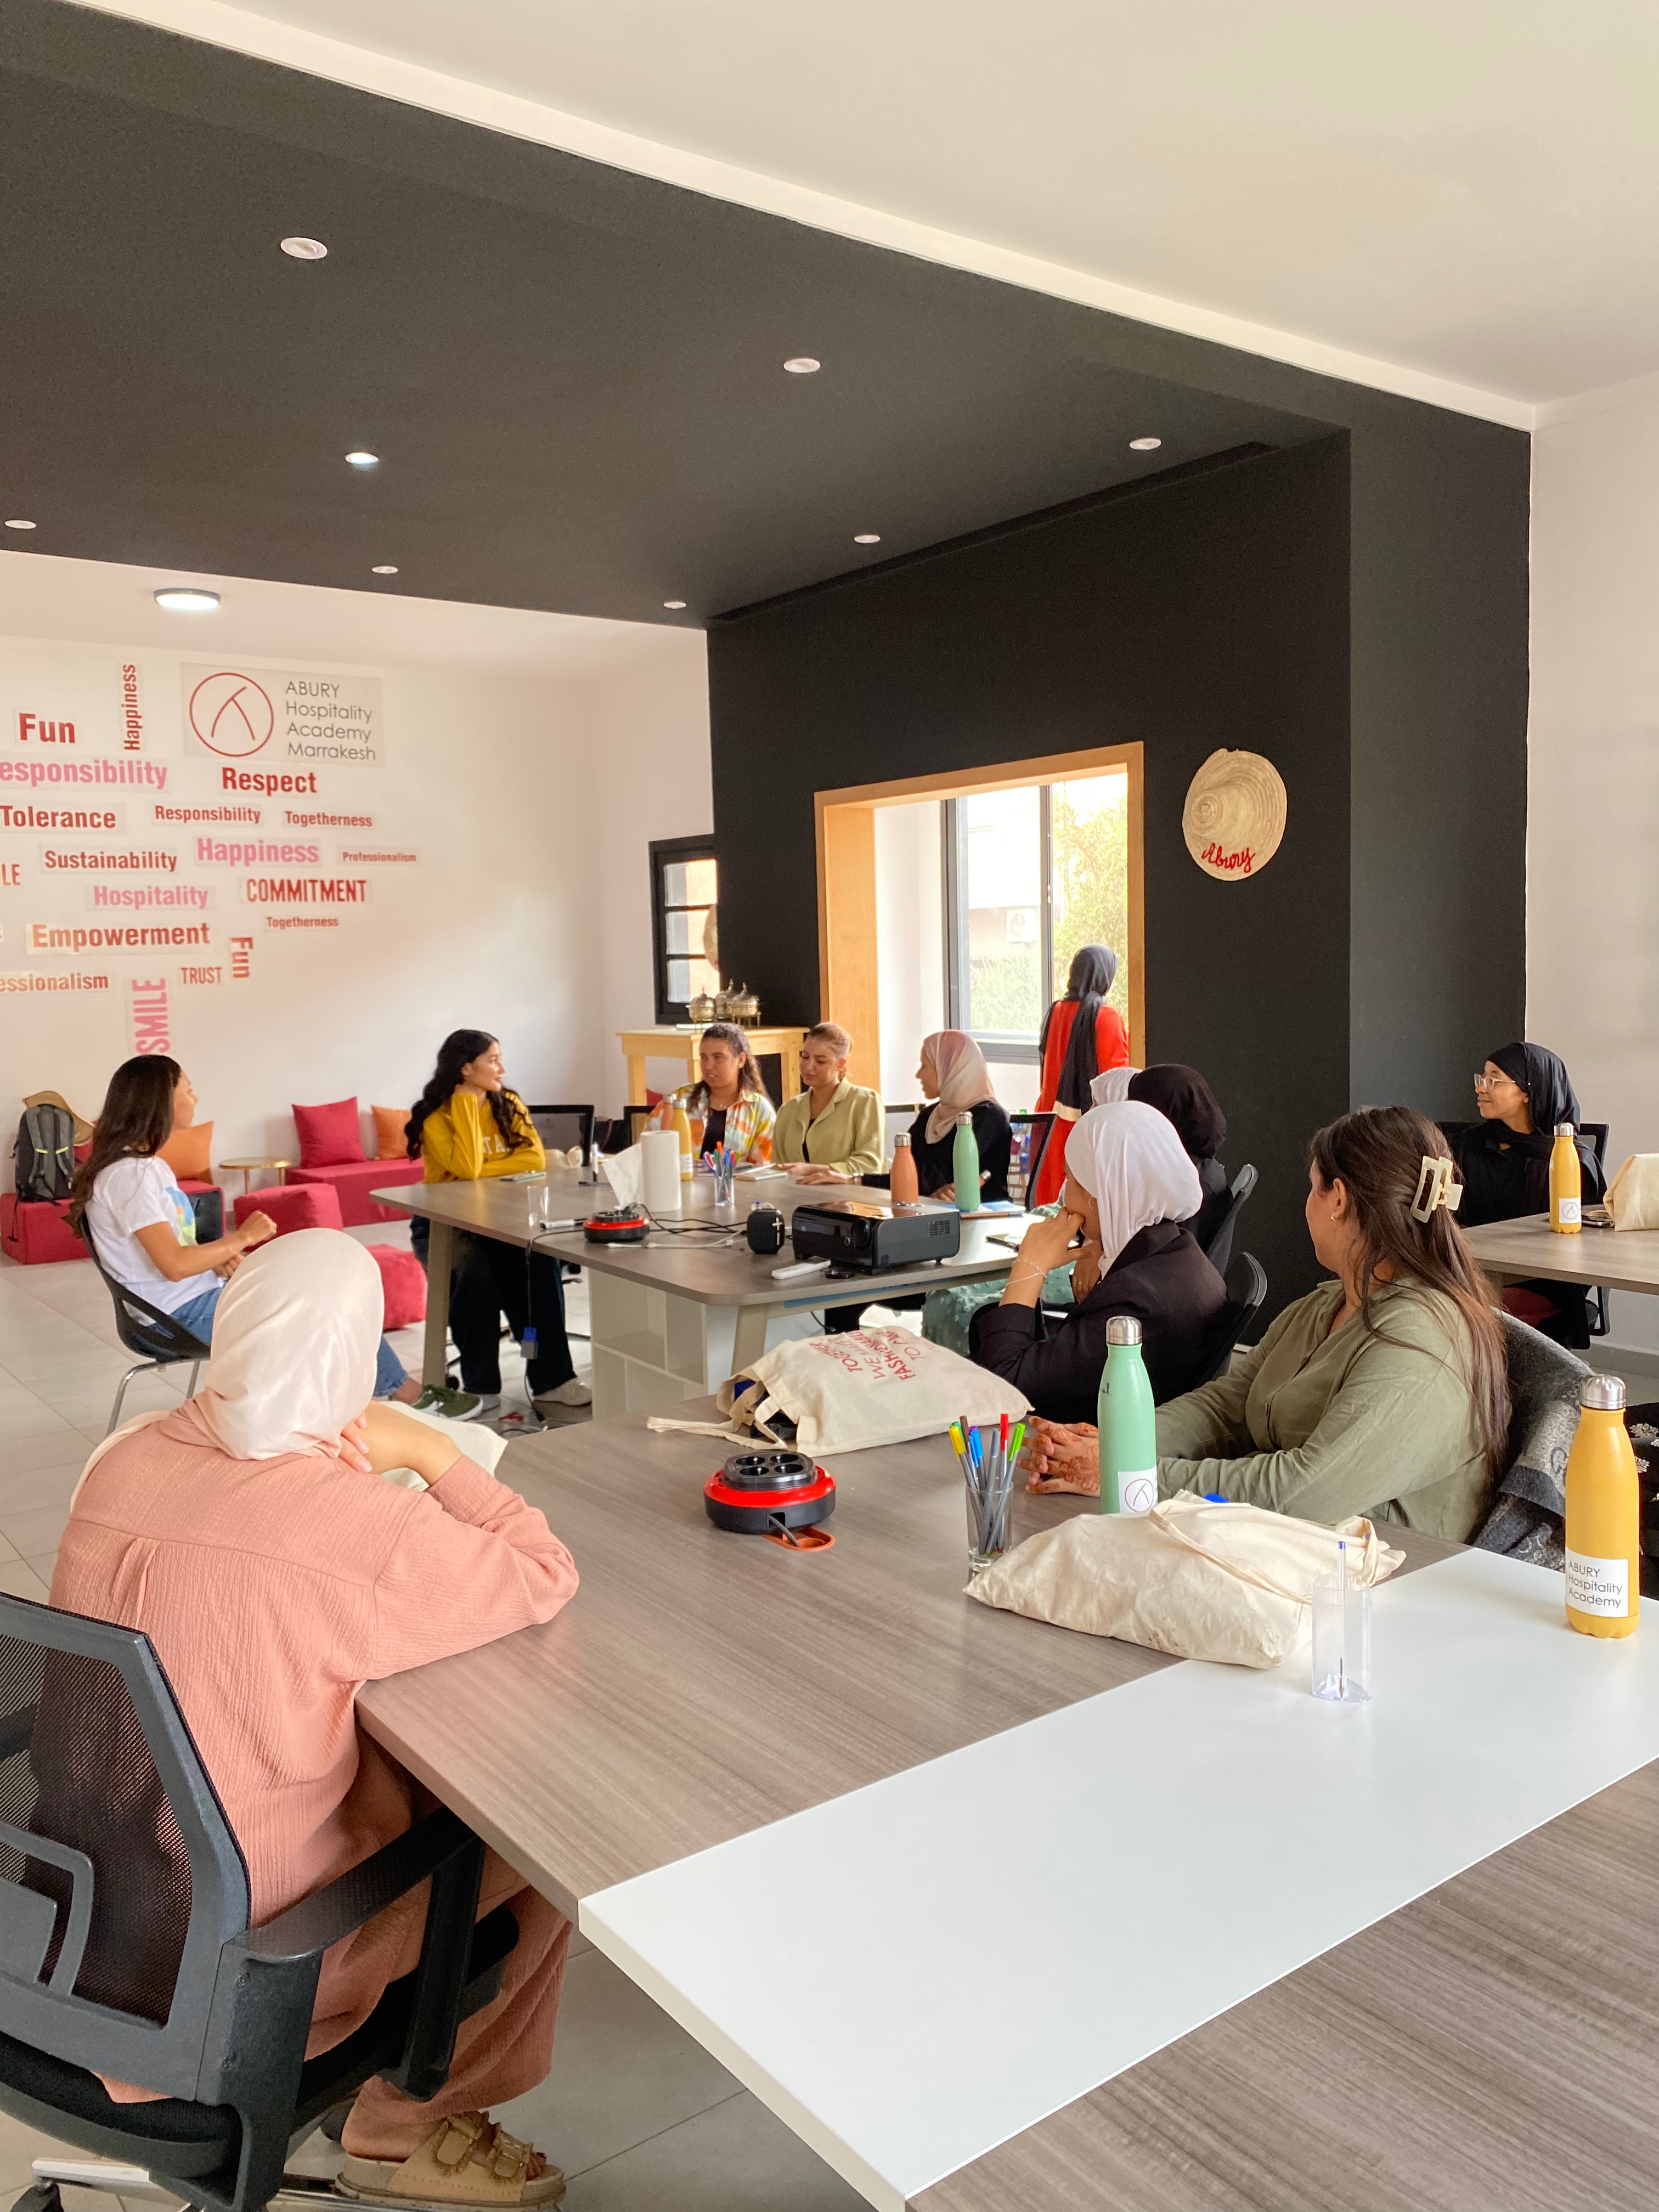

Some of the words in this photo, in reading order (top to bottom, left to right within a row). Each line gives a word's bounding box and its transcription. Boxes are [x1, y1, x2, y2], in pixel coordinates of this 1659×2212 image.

[285, 681, 340, 698] ABURY
[122, 664, 143, 751] Happiness
[286, 701, 373, 724] Hospitality
[19, 713, 76, 743] Fun
[287, 722, 371, 743] Academy
[288, 742, 376, 760] Marrakesh
[222, 767, 317, 797] Respect
[0, 805, 116, 828] Tolerance
[155, 805, 261, 824] Responsibility
[285, 810, 373, 827] Togetherness
[45, 850, 177, 873] Sustainability
[197, 838, 319, 867] Happiness
[342, 851, 417, 862] Professionalism
[94, 885, 208, 911] Hospitality
[246, 879, 367, 902] COMMITMENT
[266, 917, 339, 930] Togetherness
[32, 923, 210, 952] Empowerment
[230, 936, 253, 979] Fun
[180, 967, 223, 985] TRUST
[132, 978, 171, 1056] SMILE
[809, 1342, 863, 1373] TOGETHER
[904, 1347, 925, 1361] TO
[864, 1357, 887, 1379] WE
[1568, 1561, 1600, 1578] ABURY
[1568, 1573, 1623, 1595] Hospitality
[1568, 1587, 1622, 1609] Academy
